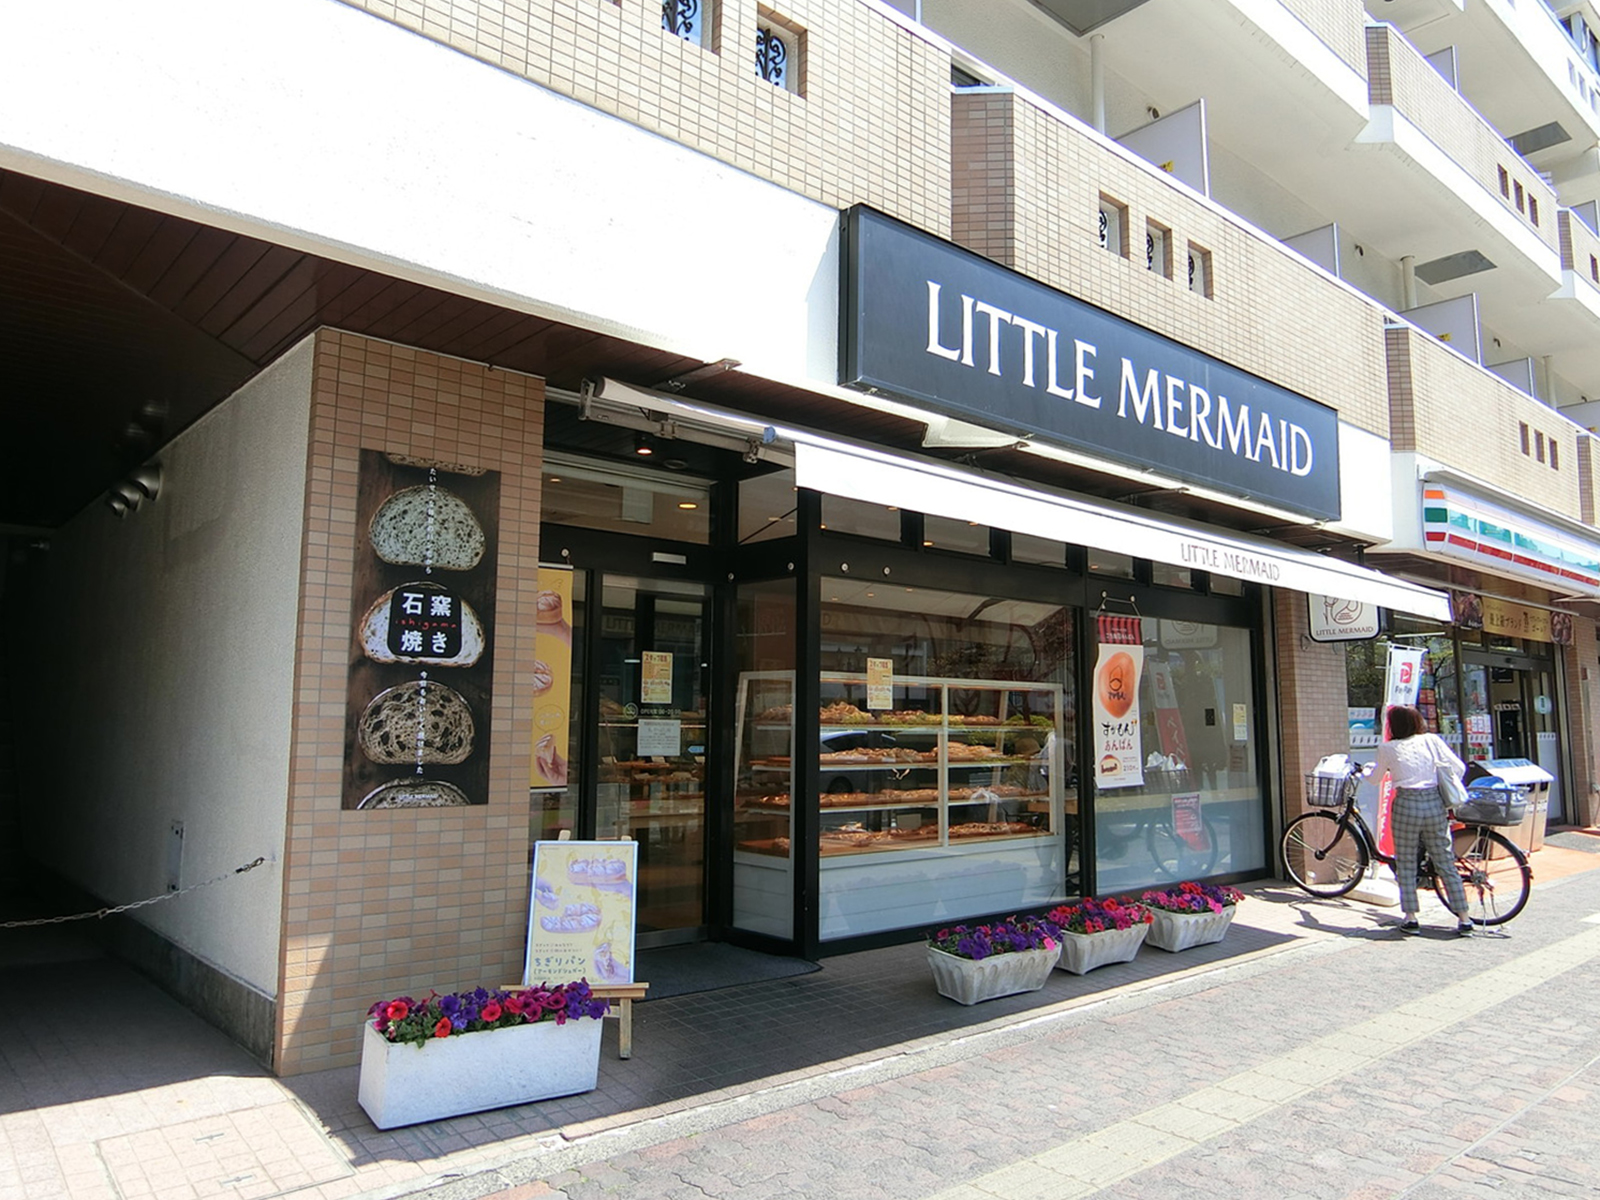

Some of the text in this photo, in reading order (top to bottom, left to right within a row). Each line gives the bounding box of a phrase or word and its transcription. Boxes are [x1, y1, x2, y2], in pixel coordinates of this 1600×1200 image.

[926, 280, 1314, 477] LITTLE MERMAID
[1181, 543, 1280, 581] LITTLE MERMAID
[402, 592, 452, 617] 石窯
[395, 618, 457, 630] ishigama
[1316, 626, 1374, 636] LITTLE MERMAID
[401, 630, 448, 653] 焼き
[534, 956, 586, 967] ちぎりパン
